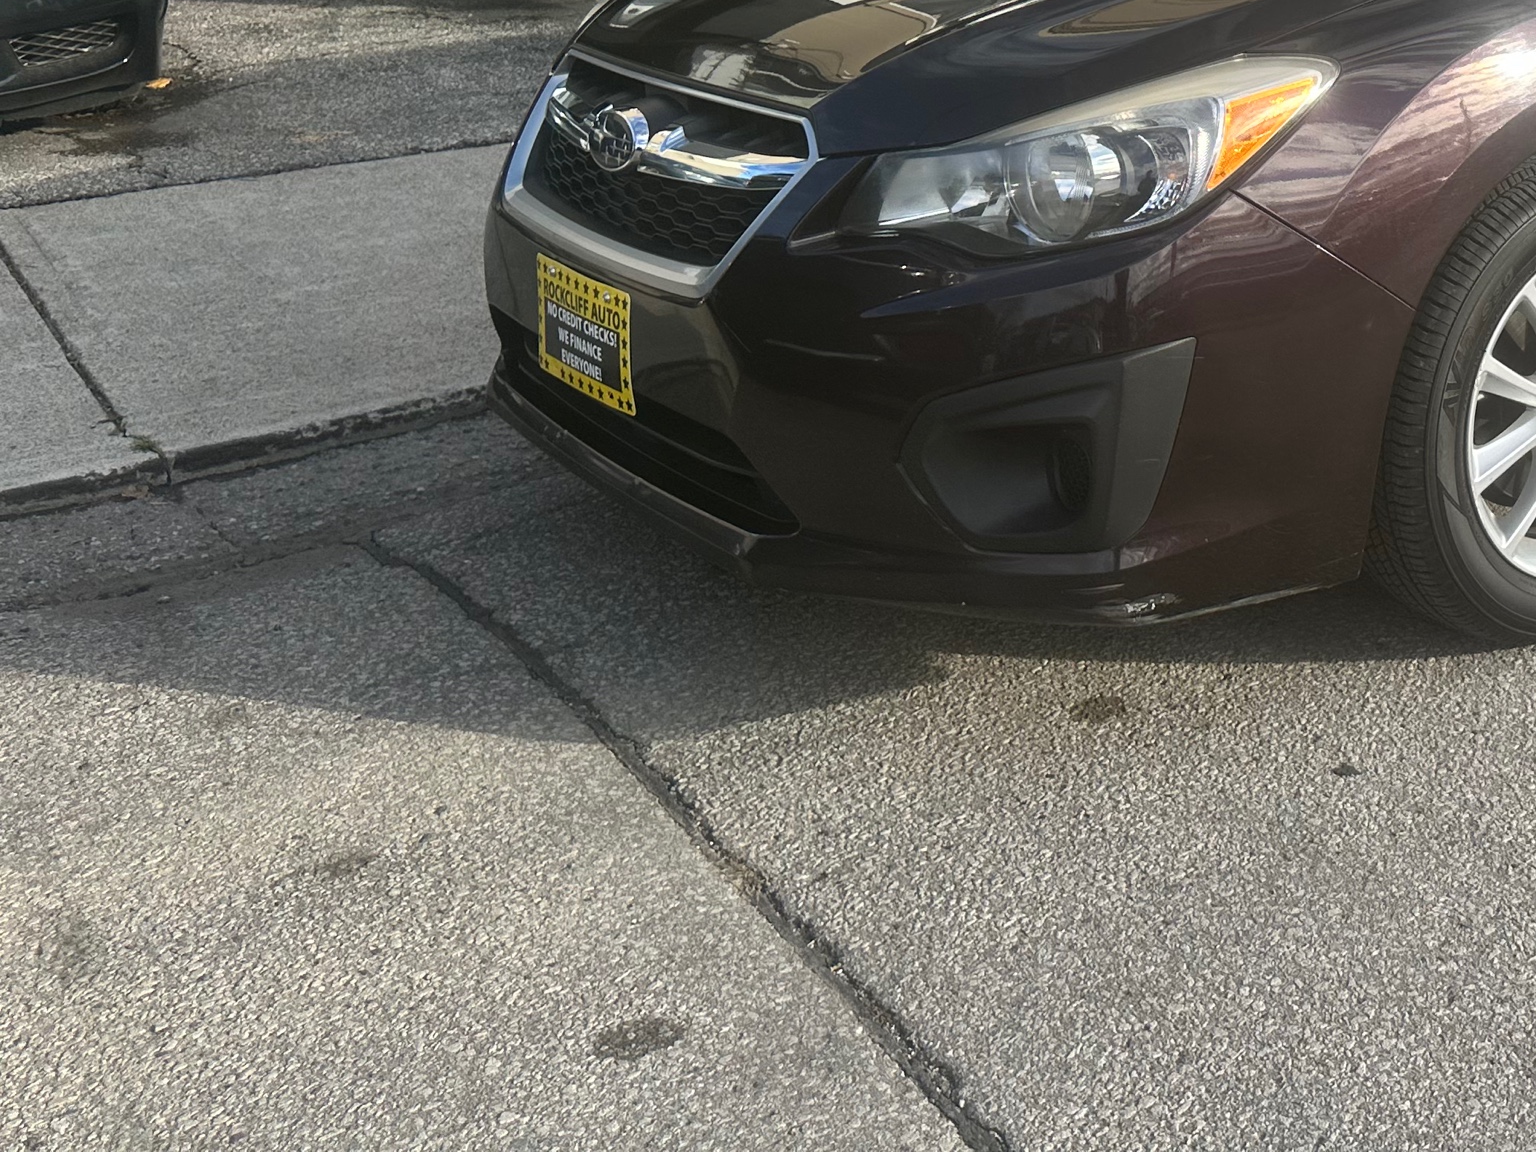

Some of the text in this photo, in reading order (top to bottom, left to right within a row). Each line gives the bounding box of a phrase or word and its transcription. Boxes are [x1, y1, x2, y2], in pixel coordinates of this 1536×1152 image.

[543, 278, 620, 330] ROCKCLIFF AUTO
[547, 301, 617, 348] NO CREDIT CHECKS!
[558, 327, 602, 361] WE FINANCE
[561, 349, 602, 382] EVERYONE!
